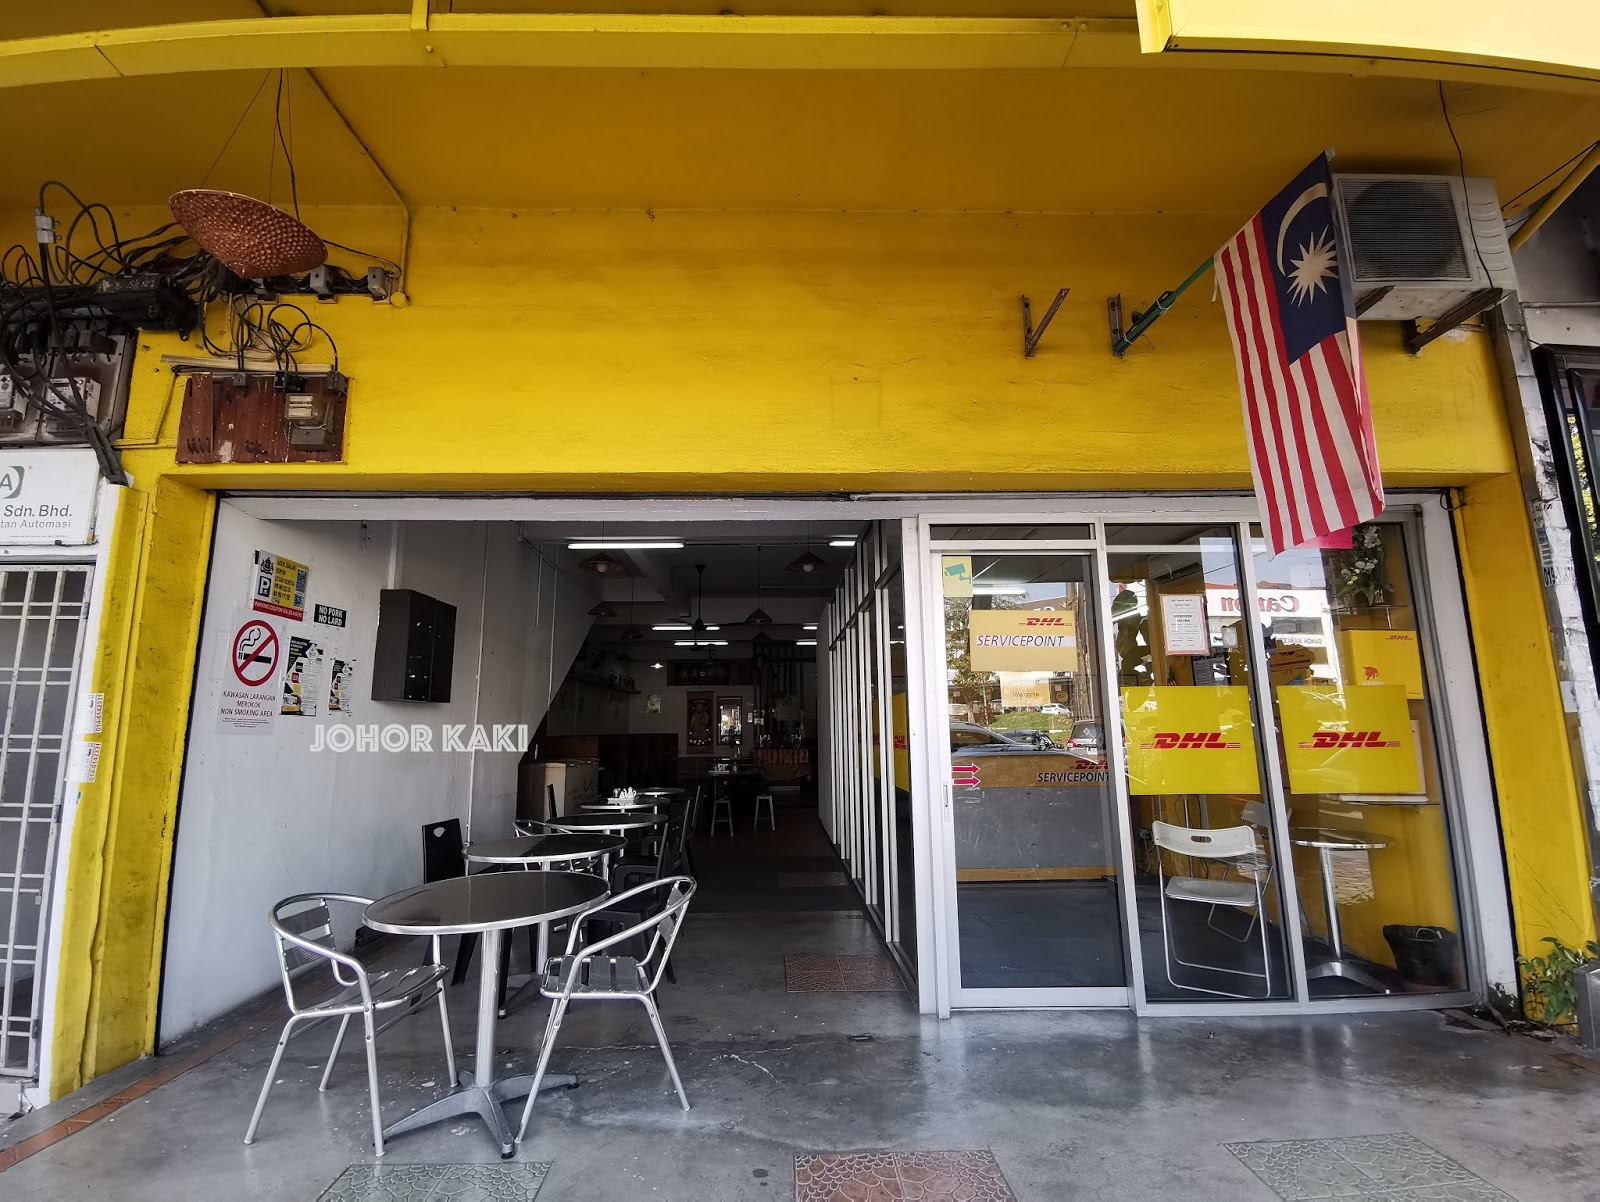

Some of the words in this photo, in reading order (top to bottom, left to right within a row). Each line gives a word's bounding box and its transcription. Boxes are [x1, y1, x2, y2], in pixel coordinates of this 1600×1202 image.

[3, 504, 35, 517] Sdn.
[39, 504, 72, 517] Bhd.
[20, 520, 71, 528] Automasi
[319, 606, 328, 615] NO
[328, 608, 343, 618] PORK
[318, 614, 327, 623] NO
[328, 616, 343, 626] LARD
[1025, 617, 1065, 626] DHL
[977, 635, 1065, 647] SERVICEPOINT
[223, 690, 249, 699] KAWASAN
[250, 693, 276, 701] LARANGAN
[237, 700, 261, 708] MEROKOK
[234, 709, 259, 717] SMOKING
[1153, 732, 1228, 749] DHL
[1312, 731, 1388, 748] DHL
